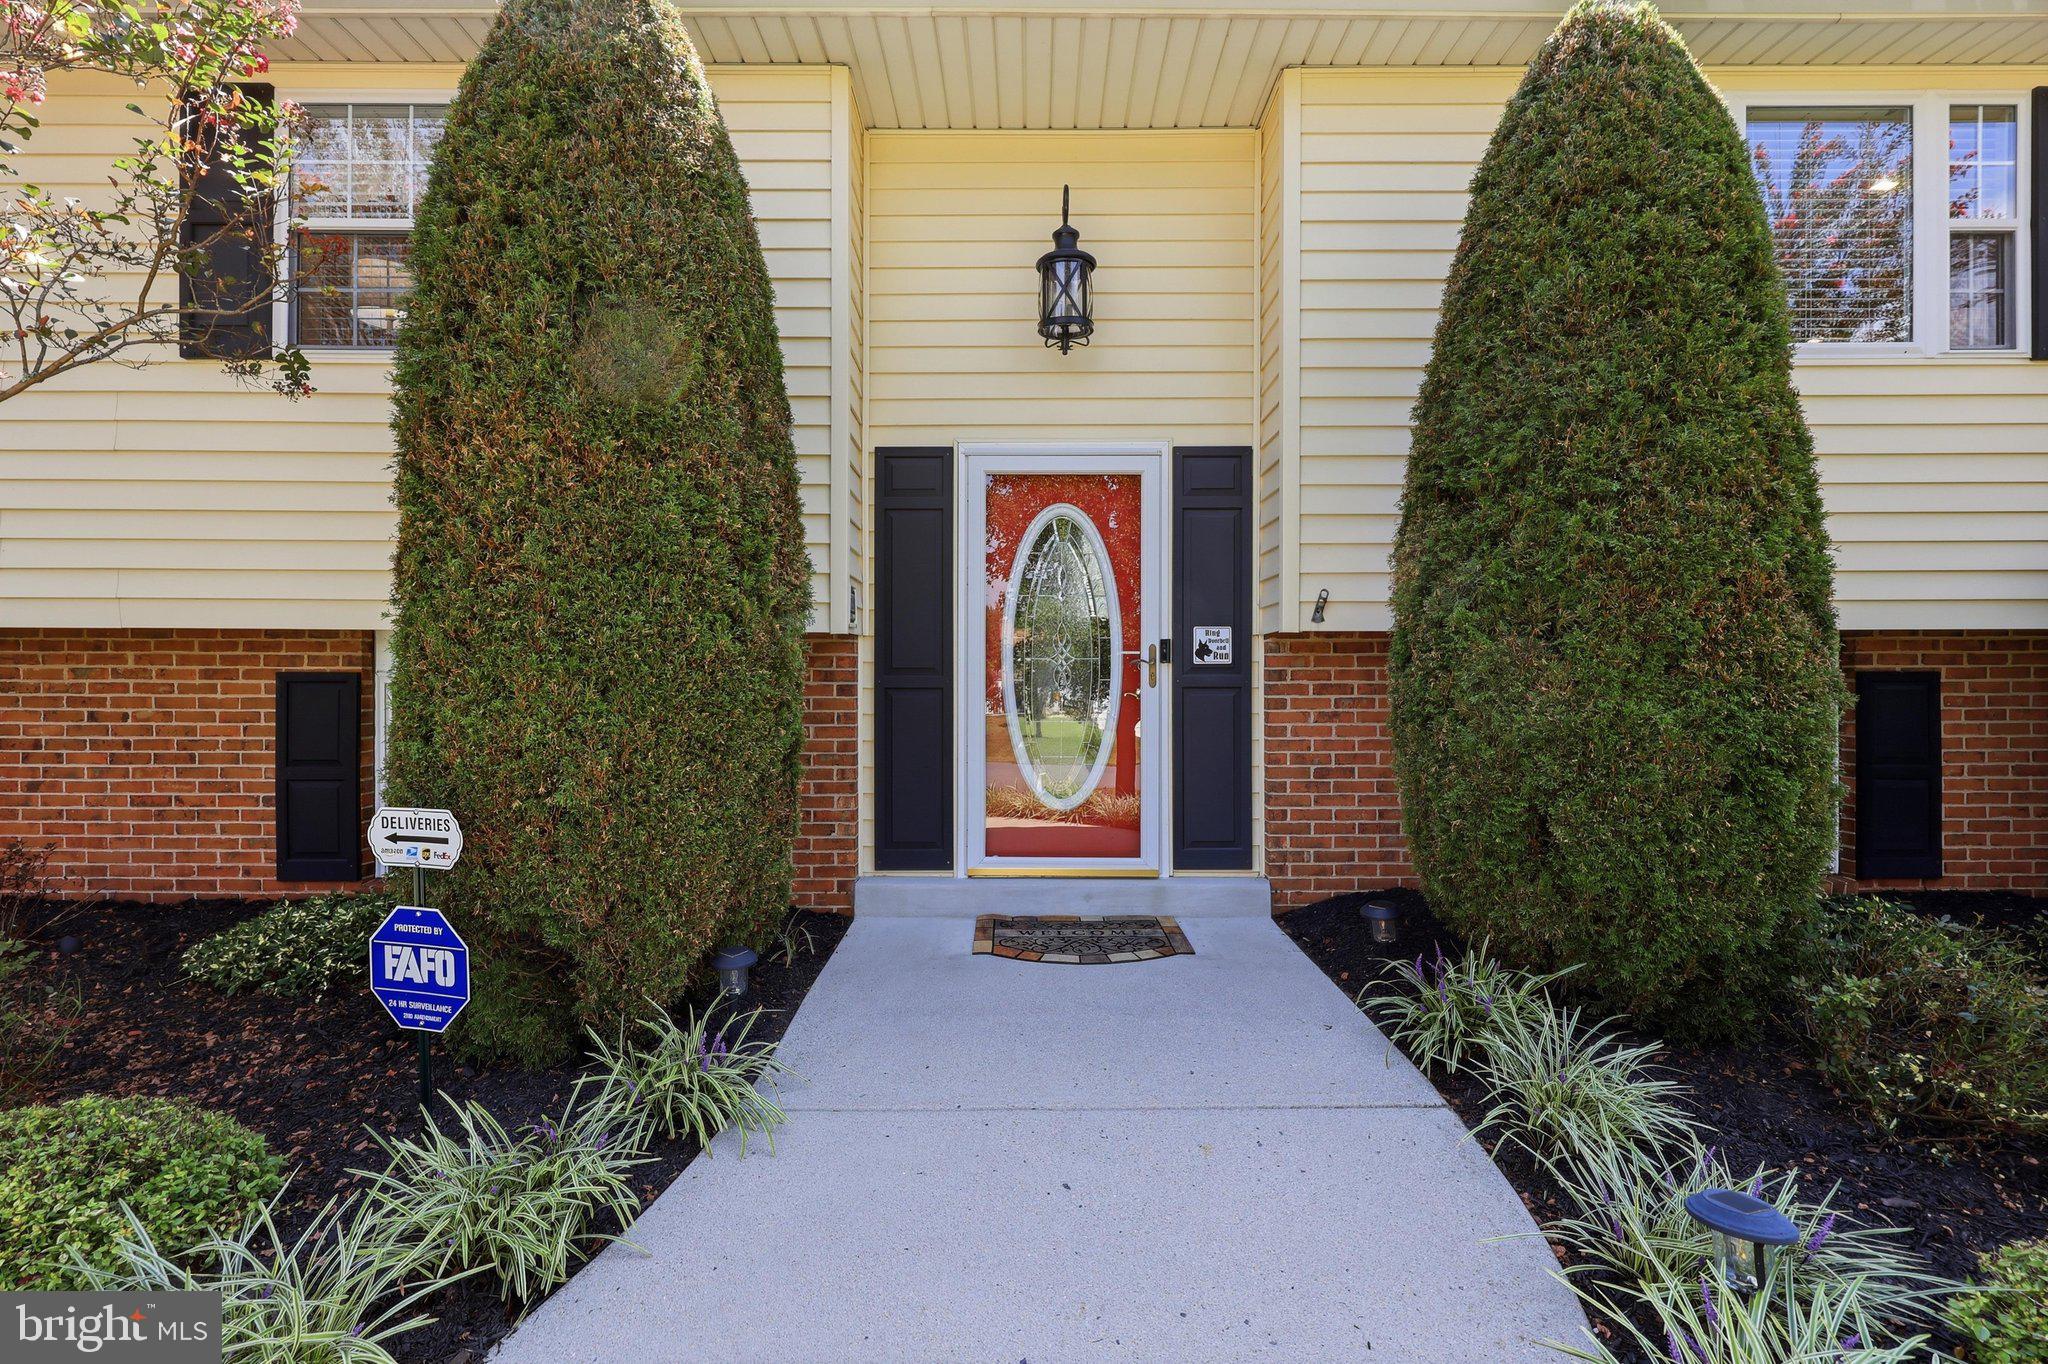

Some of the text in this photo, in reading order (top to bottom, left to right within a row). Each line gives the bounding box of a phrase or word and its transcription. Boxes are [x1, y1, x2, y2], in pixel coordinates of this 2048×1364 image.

[1205, 629, 1220, 637] Ring
[1213, 651, 1229, 660] Run
[381, 816, 451, 832] DELIVERIES
[380, 847, 404, 855] amazon
[433, 851, 452, 861] FedEx
[394, 923, 443, 936] PROTECTED BY
[384, 944, 455, 988] FAFO
[388, 999, 452, 1013] 24 HR SURVEILLANCE
